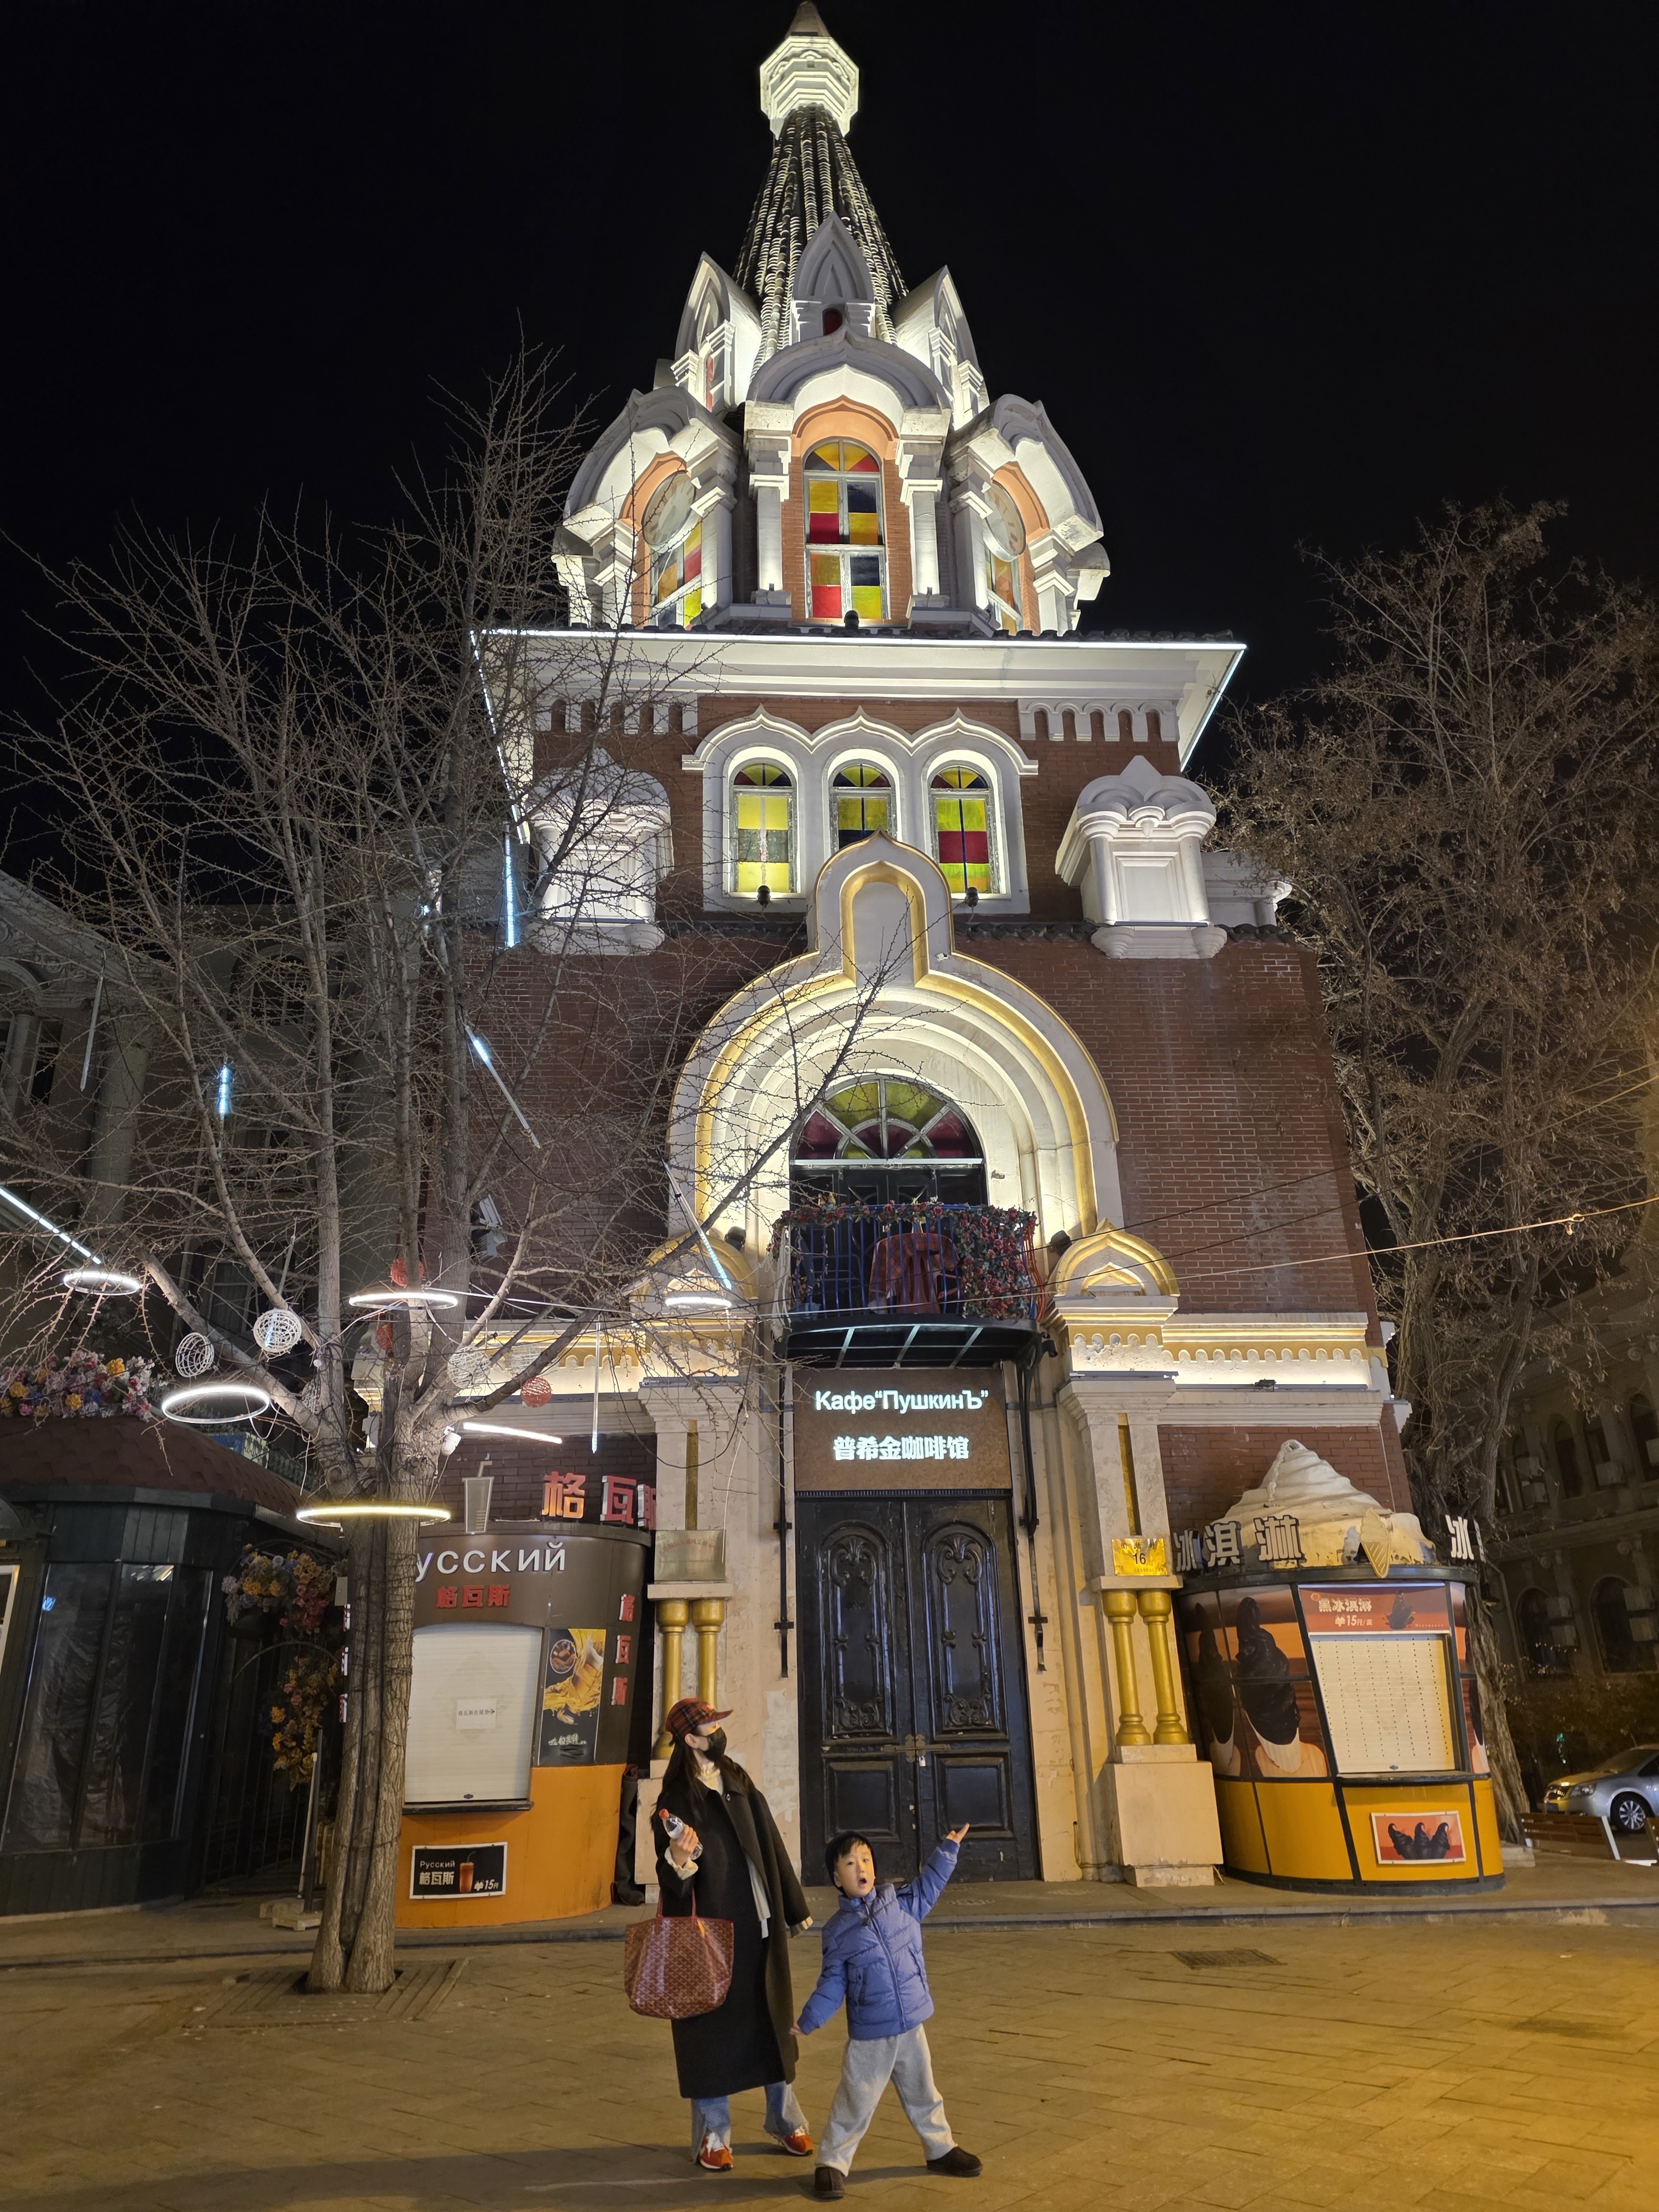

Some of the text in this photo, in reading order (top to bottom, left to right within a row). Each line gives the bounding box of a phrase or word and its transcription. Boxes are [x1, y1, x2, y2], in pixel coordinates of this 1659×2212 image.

[833, 1436, 970, 1461] 普希金咖啡馆
[1173, 1515, 1302, 1572] 冰淇淋
[415, 1541, 565, 1583] усский
[1133, 1552, 1146, 1565] 16
[436, 1584, 510, 1609] 格瓦斯
[420, 1860, 455, 1870] Русский
[419, 1871, 455, 1886] 格瓦斯
